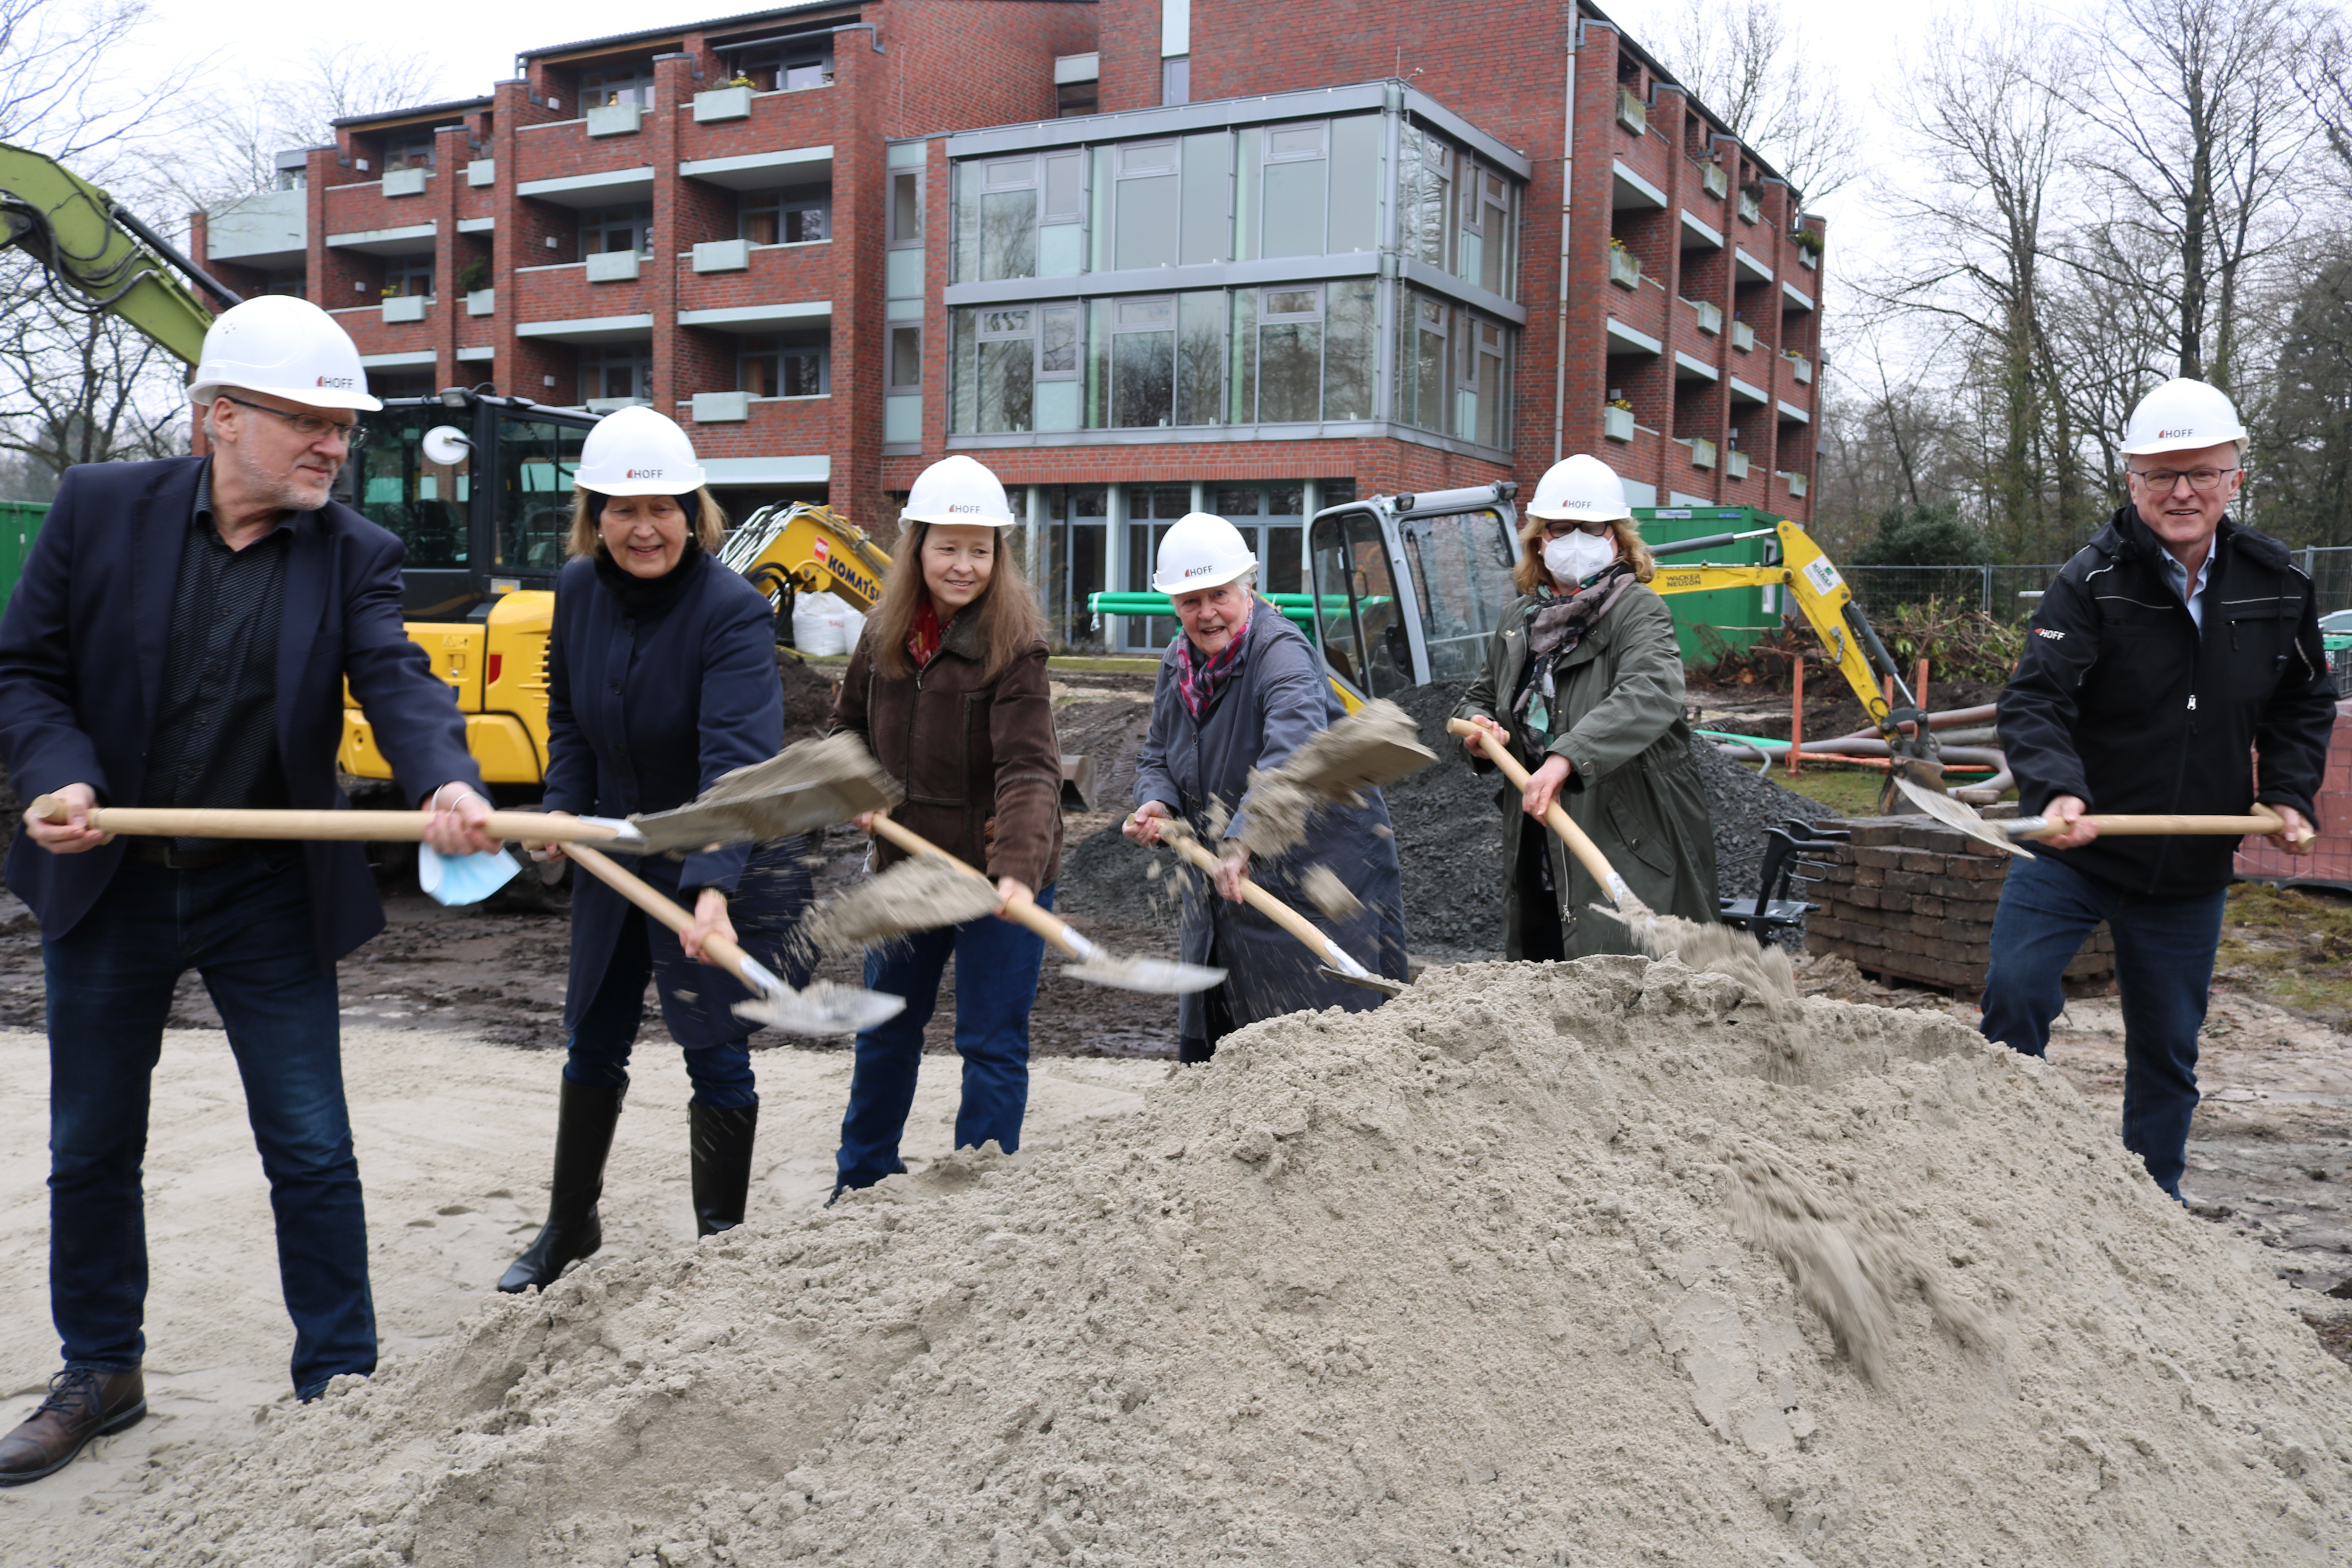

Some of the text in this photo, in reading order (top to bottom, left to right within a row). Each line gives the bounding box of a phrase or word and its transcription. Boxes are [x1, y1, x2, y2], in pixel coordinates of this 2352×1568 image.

[323, 377, 354, 388] HOFF
[2165, 429, 2193, 438] HOFF
[634, 469, 663, 479] HOFF
[955, 505, 980, 513] HOFF
[1190, 565, 1212, 577] HOFF
[2039, 629, 2066, 640] HOFF
